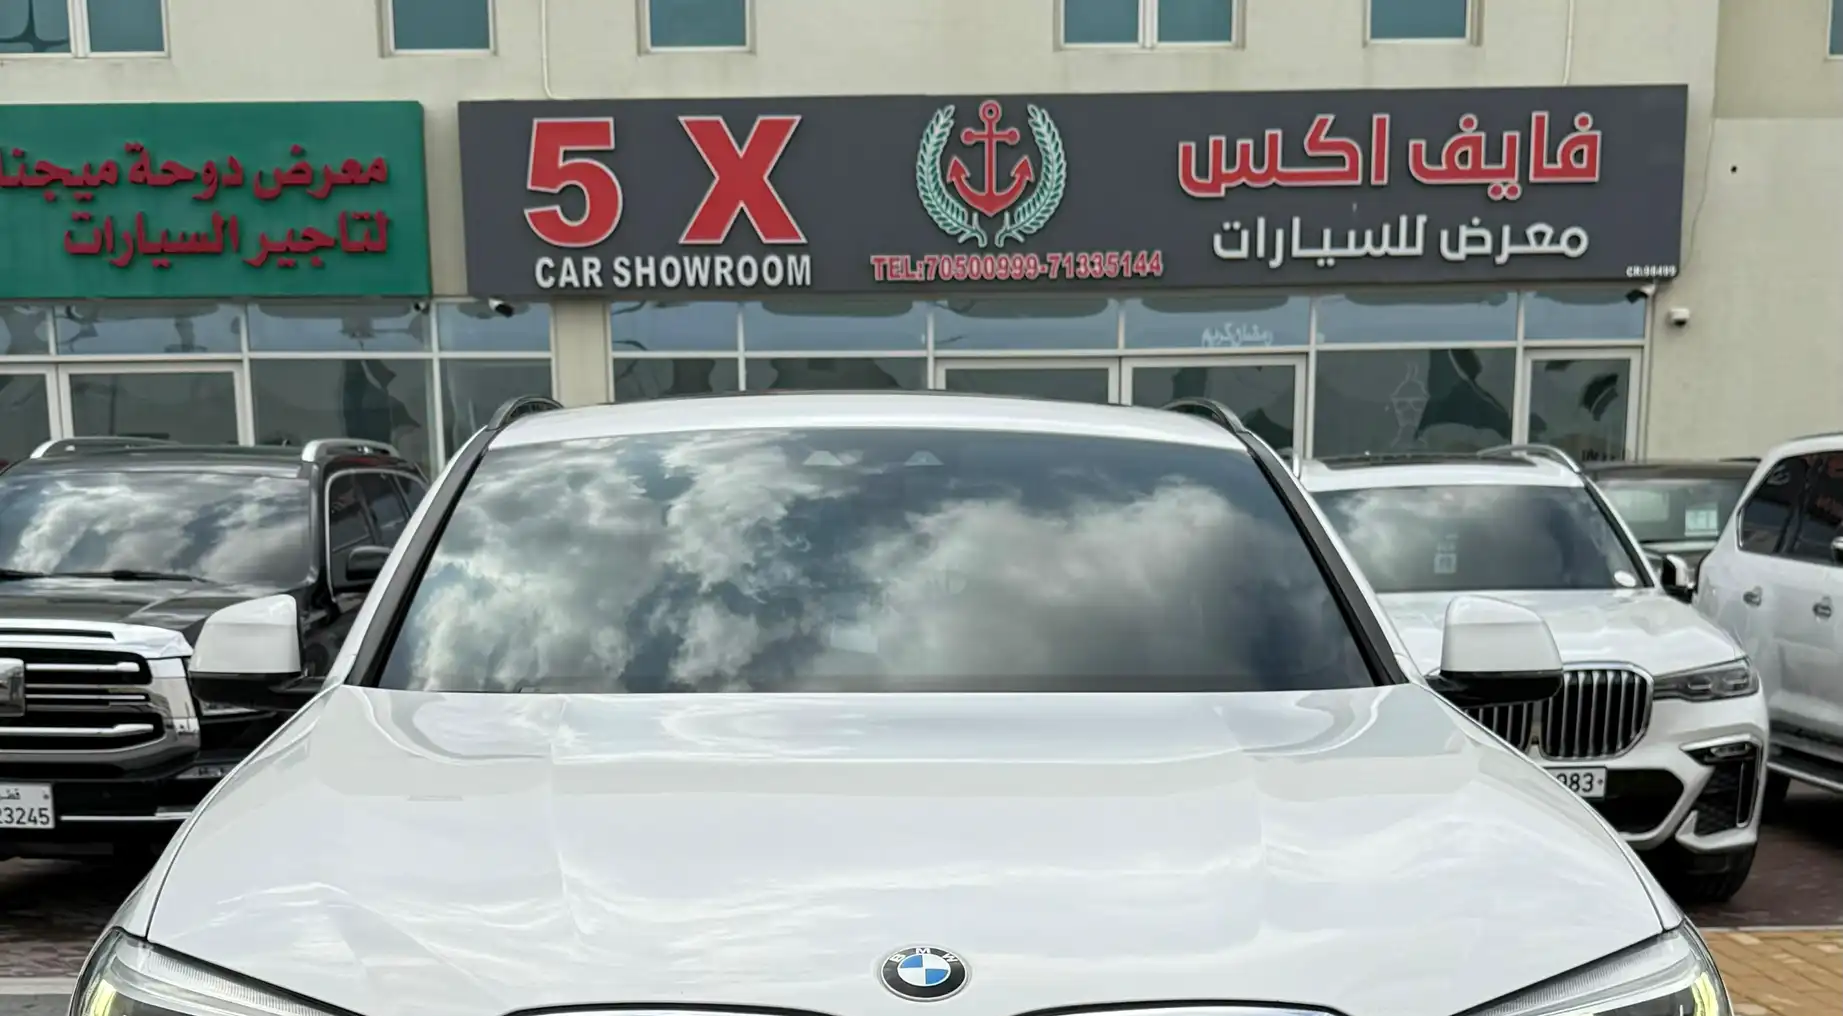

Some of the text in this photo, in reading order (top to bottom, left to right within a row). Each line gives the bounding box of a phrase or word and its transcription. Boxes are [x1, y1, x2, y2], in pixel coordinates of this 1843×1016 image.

[126, 142, 243, 200] دوحة
[254, 144, 389, 199] معرض
[524, 115, 807, 247] 5 X
[1177, 111, 1601, 200] فايف اكس
[64, 210, 390, 268] لتاجير السيارات
[1213, 214, 1590, 268] معرض للسيارات
[535, 256, 811, 288] CAR SHOWROOM
[0, 807, 50, 825] 3245
[889, 947, 959, 963] BMW
